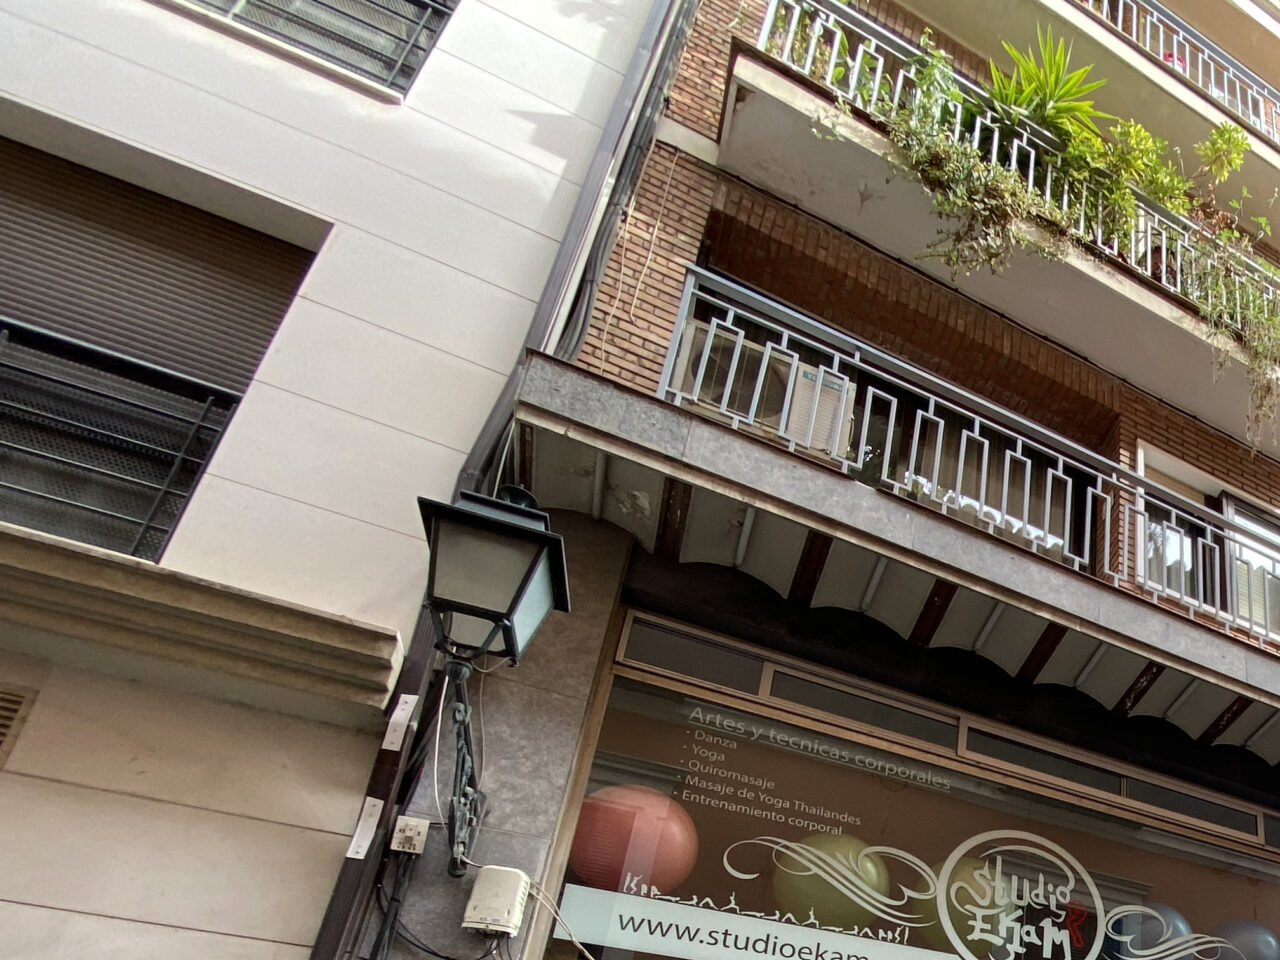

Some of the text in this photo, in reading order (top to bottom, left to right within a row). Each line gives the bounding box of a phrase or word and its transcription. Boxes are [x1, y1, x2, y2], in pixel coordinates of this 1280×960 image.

[688, 706, 952, 791] Artes y tecnicas corporales
[691, 743, 726, 763] Yoga
[694, 729, 738, 749] Danza
[688, 759, 776, 790] Quiromasaje
[682, 789, 843, 836] Entrenamiento corporal
[684, 774, 862, 826] Masaje de Yoga Thailandes
